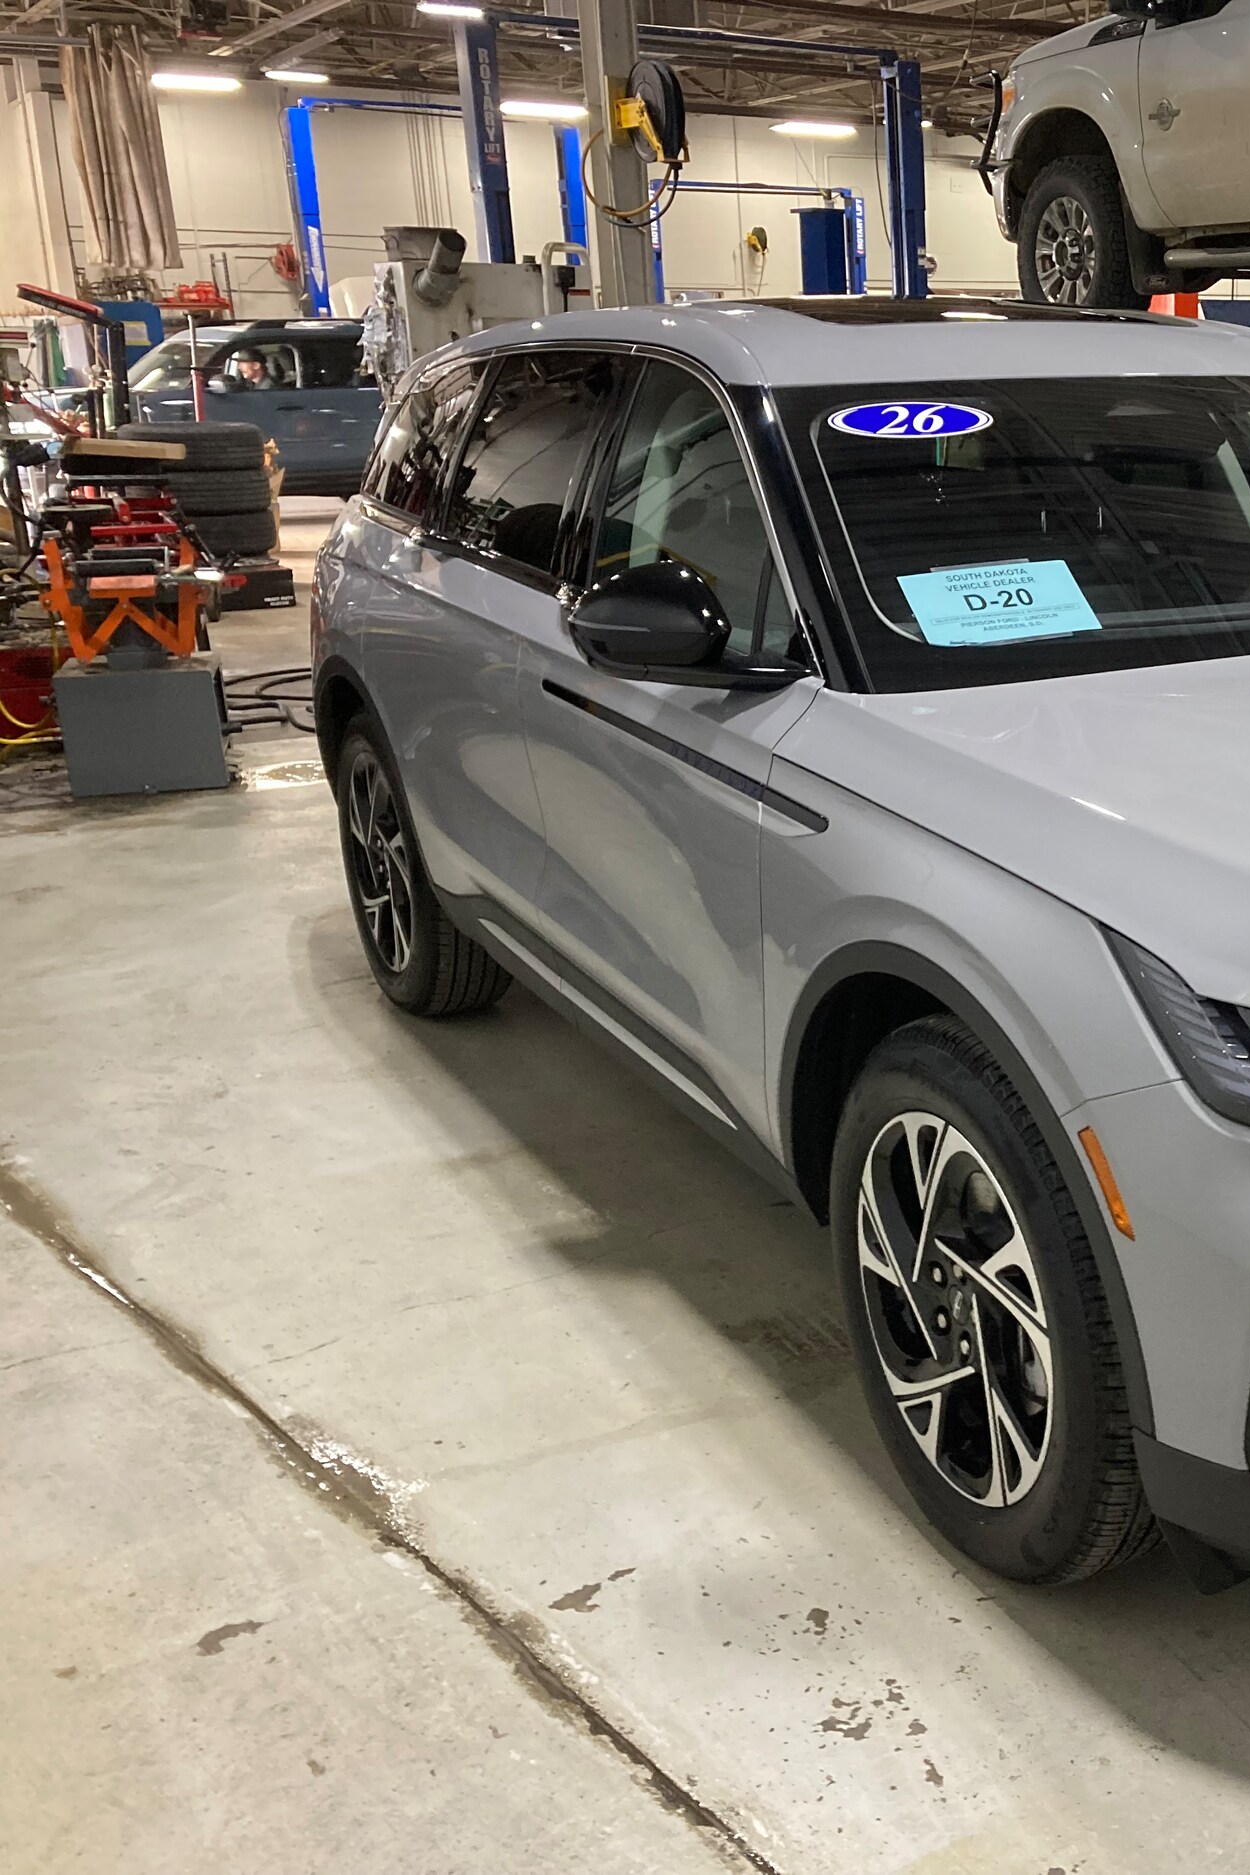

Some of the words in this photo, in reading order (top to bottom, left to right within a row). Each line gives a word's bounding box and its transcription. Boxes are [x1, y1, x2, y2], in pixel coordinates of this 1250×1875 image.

[478, 47, 496, 142] ROTARY
[484, 143, 501, 154] LIFT
[855, 198, 863, 216] LIFT
[856, 217, 864, 250] ROTARY
[875, 405, 947, 435] 26
[945, 572, 982, 582] SOUTH
[984, 568, 1028, 579] DAKOTA
[945, 580, 991, 592] VEHICLE
[993, 576, 1036, 587] DEALER
[963, 588, 1034, 611] D-20
[1024, 612, 1059, 621] LINCOLN
